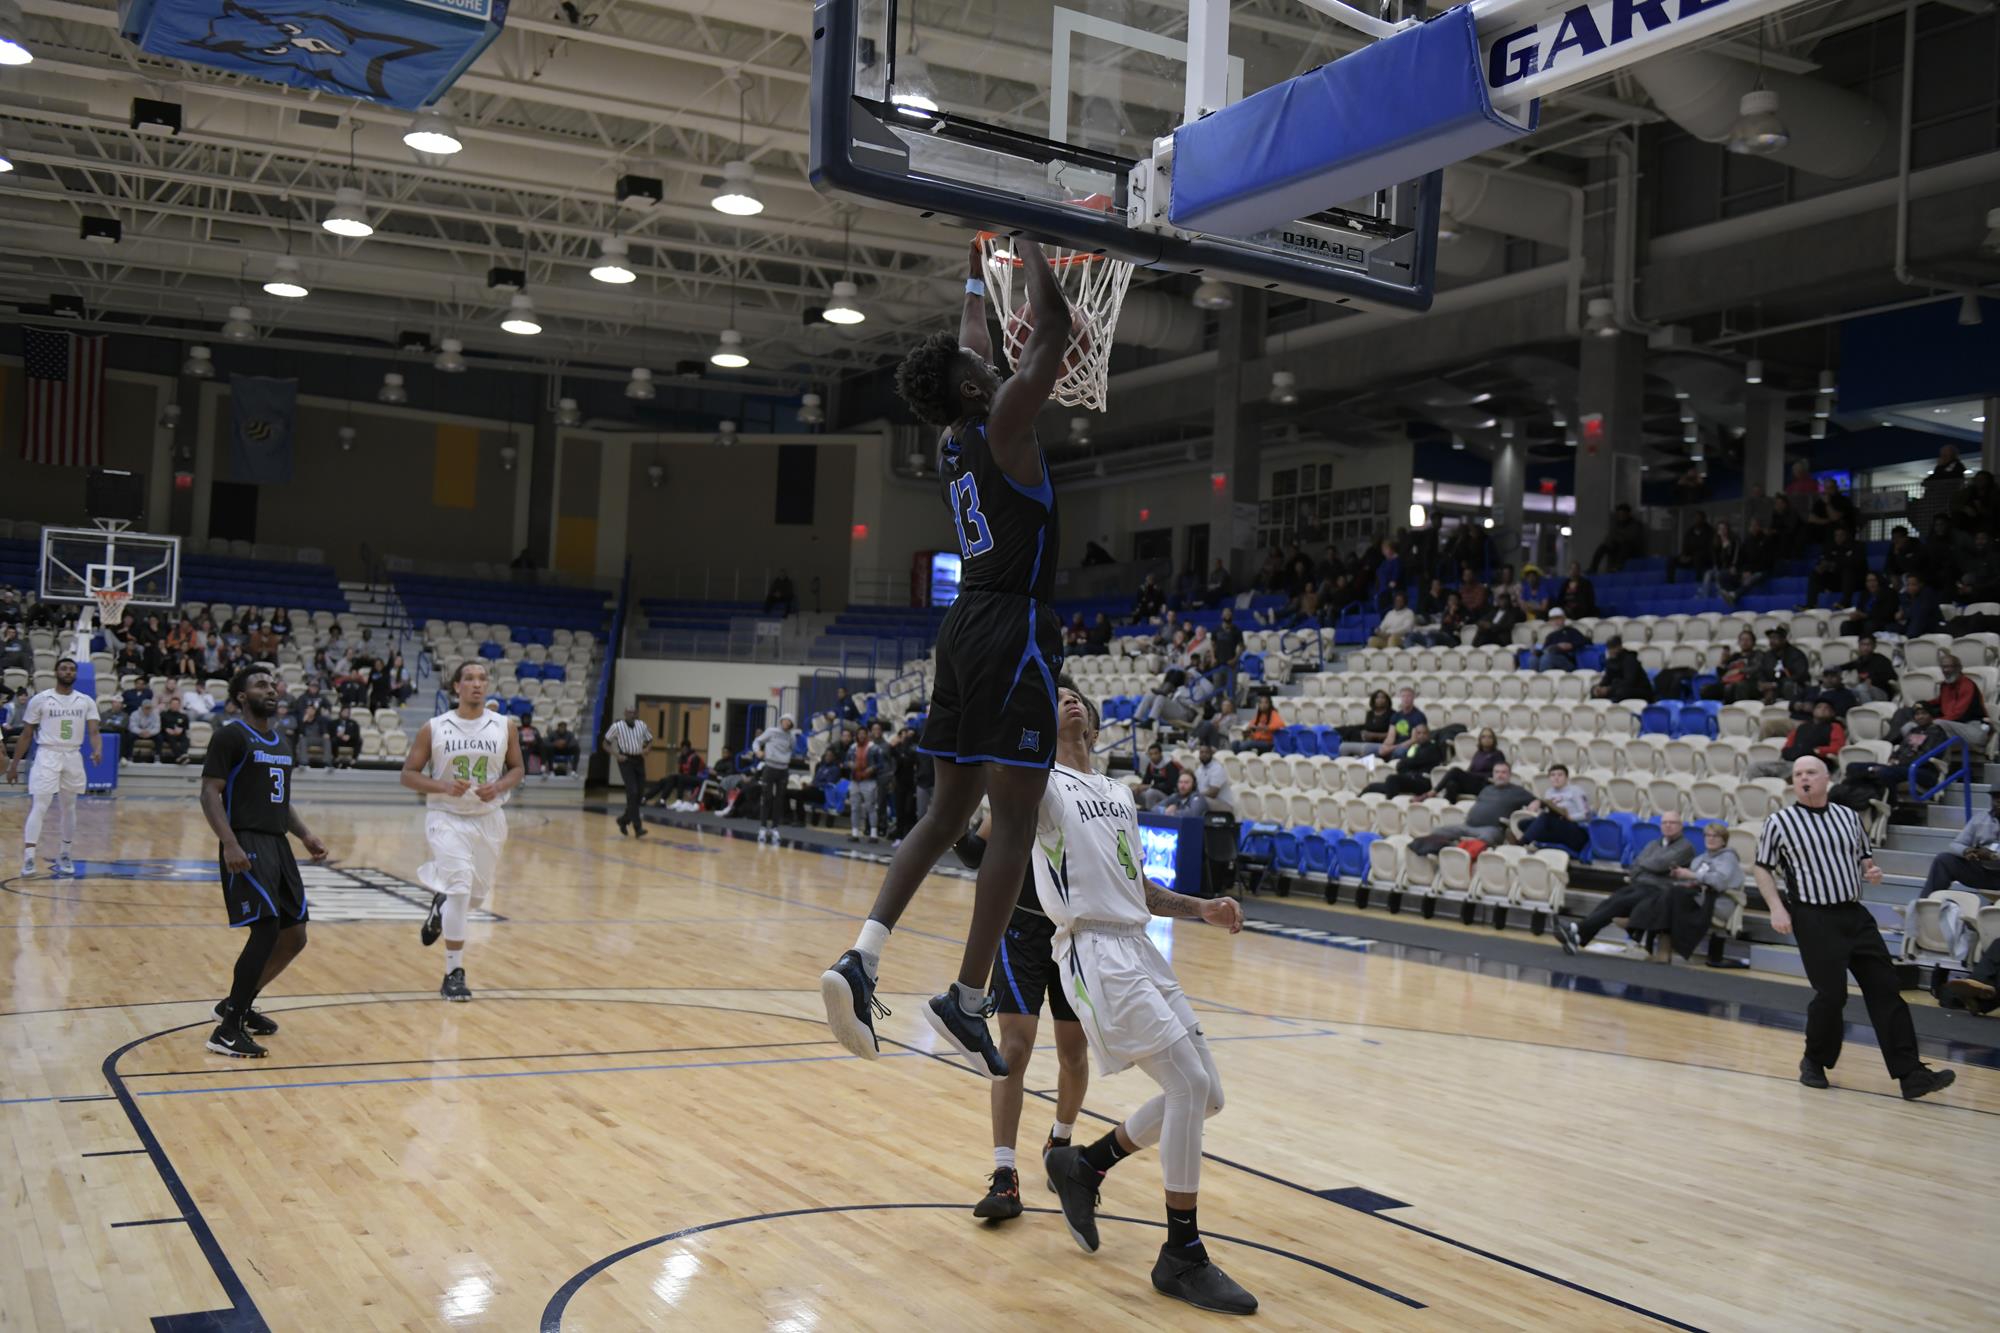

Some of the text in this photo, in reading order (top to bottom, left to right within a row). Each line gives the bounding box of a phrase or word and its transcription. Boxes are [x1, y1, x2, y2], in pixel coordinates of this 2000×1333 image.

[949, 471, 994, 559] 13
[60, 719, 73, 740] 5
[443, 739, 498, 755] ALLEGANY
[269, 766, 285, 803] 3
[452, 754, 489, 784] 34
[1116, 829, 1138, 881] 4
